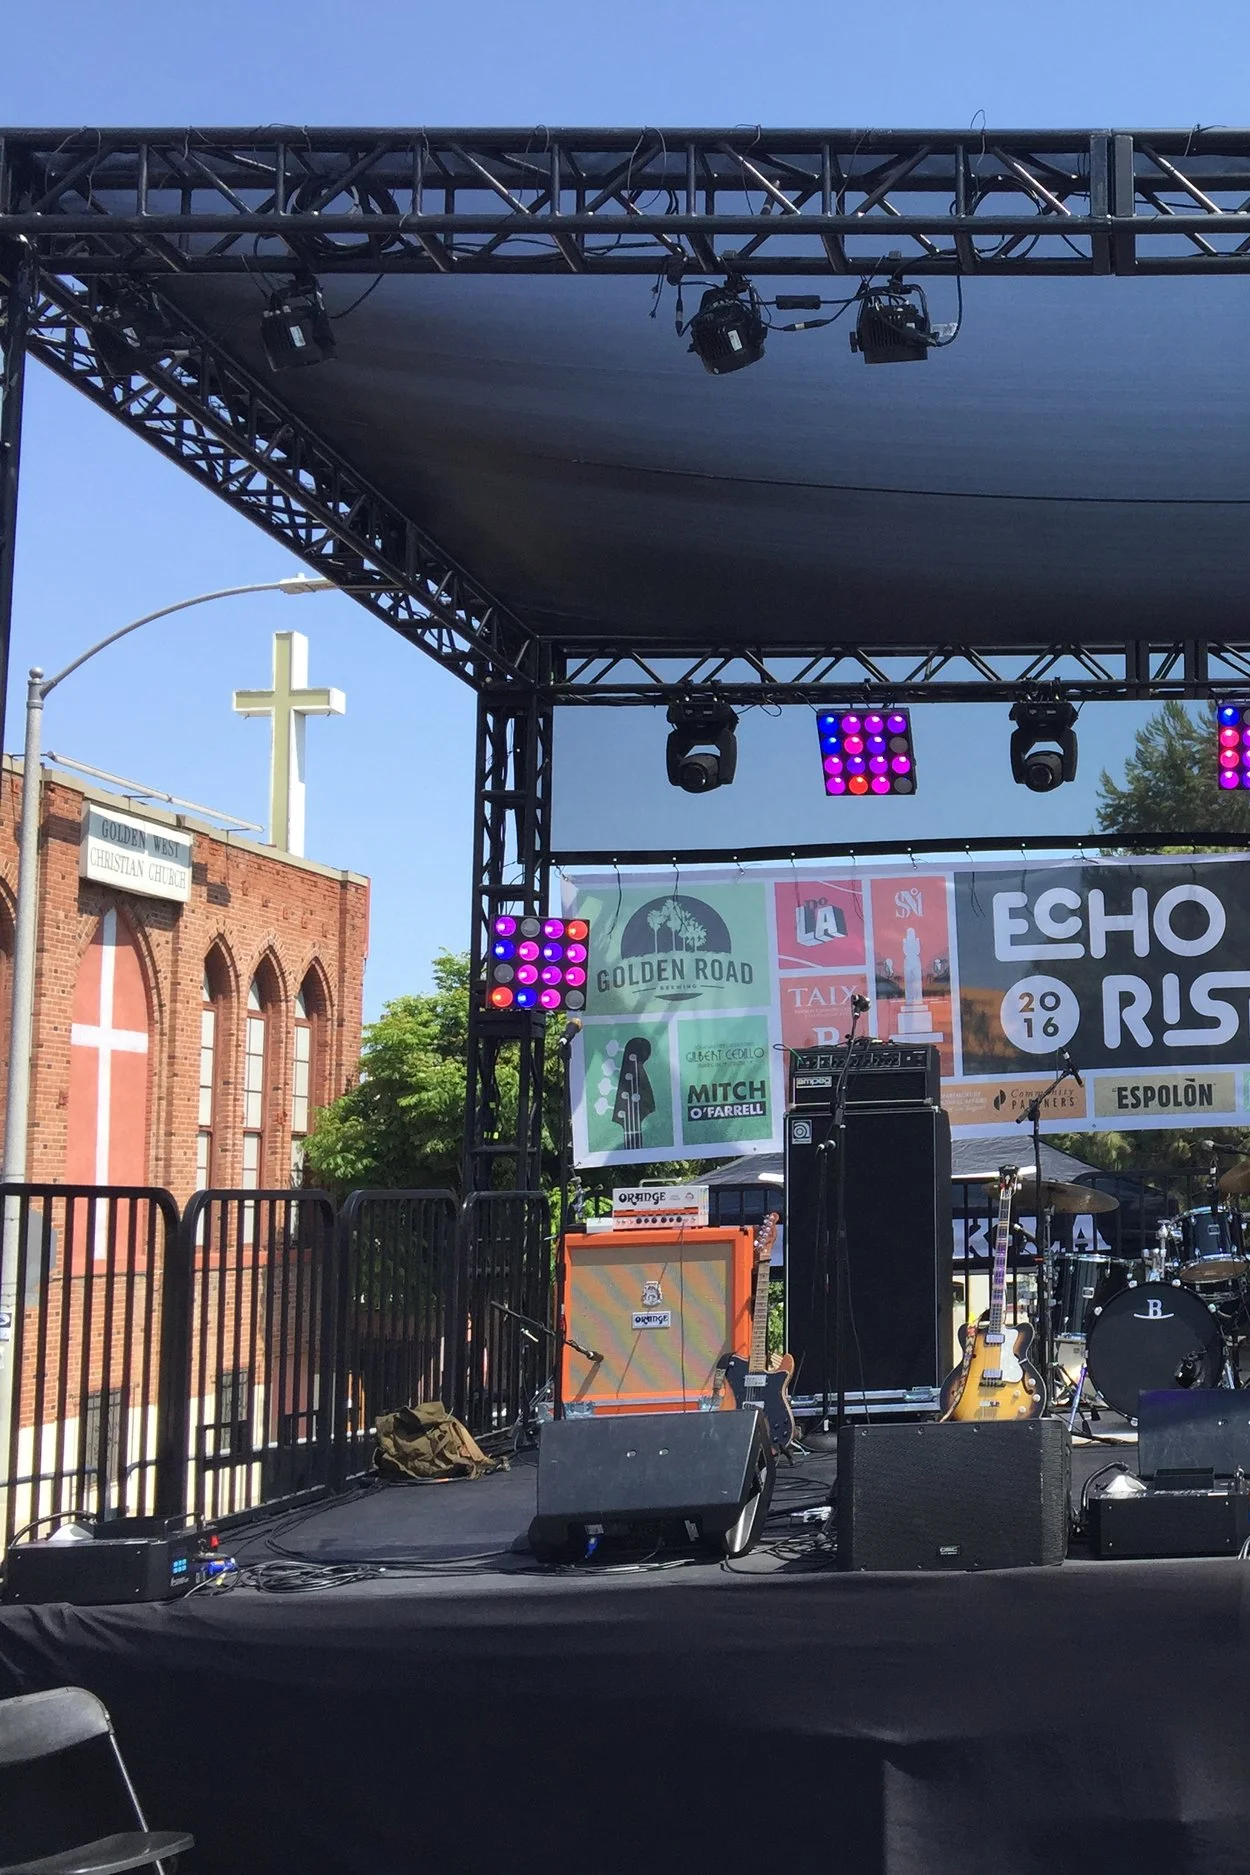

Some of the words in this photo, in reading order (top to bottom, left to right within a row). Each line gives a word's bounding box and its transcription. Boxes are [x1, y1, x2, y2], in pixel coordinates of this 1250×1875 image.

[102, 819, 146, 849] GOLDEN
[153, 834, 180, 858] WEST
[89, 847, 145, 878] CHRISTIAN
[149, 863, 186, 889] CHURCH
[796, 905, 848, 947] LA
[992, 884, 1226, 961] ECHO
[597, 958, 685, 993] GOLDEN
[695, 958, 753, 985] ROAD
[788, 984, 857, 1008] TAIX
[1018, 991, 1061, 1013] 20
[1023, 1016, 1060, 1038] 16
[687, 1080, 766, 1104] MITCH
[1011, 1088, 1074, 1098] Commnity
[1012, 1097, 1075, 1110] PANERS
[690, 1103, 764, 1119] O'FARRELL
